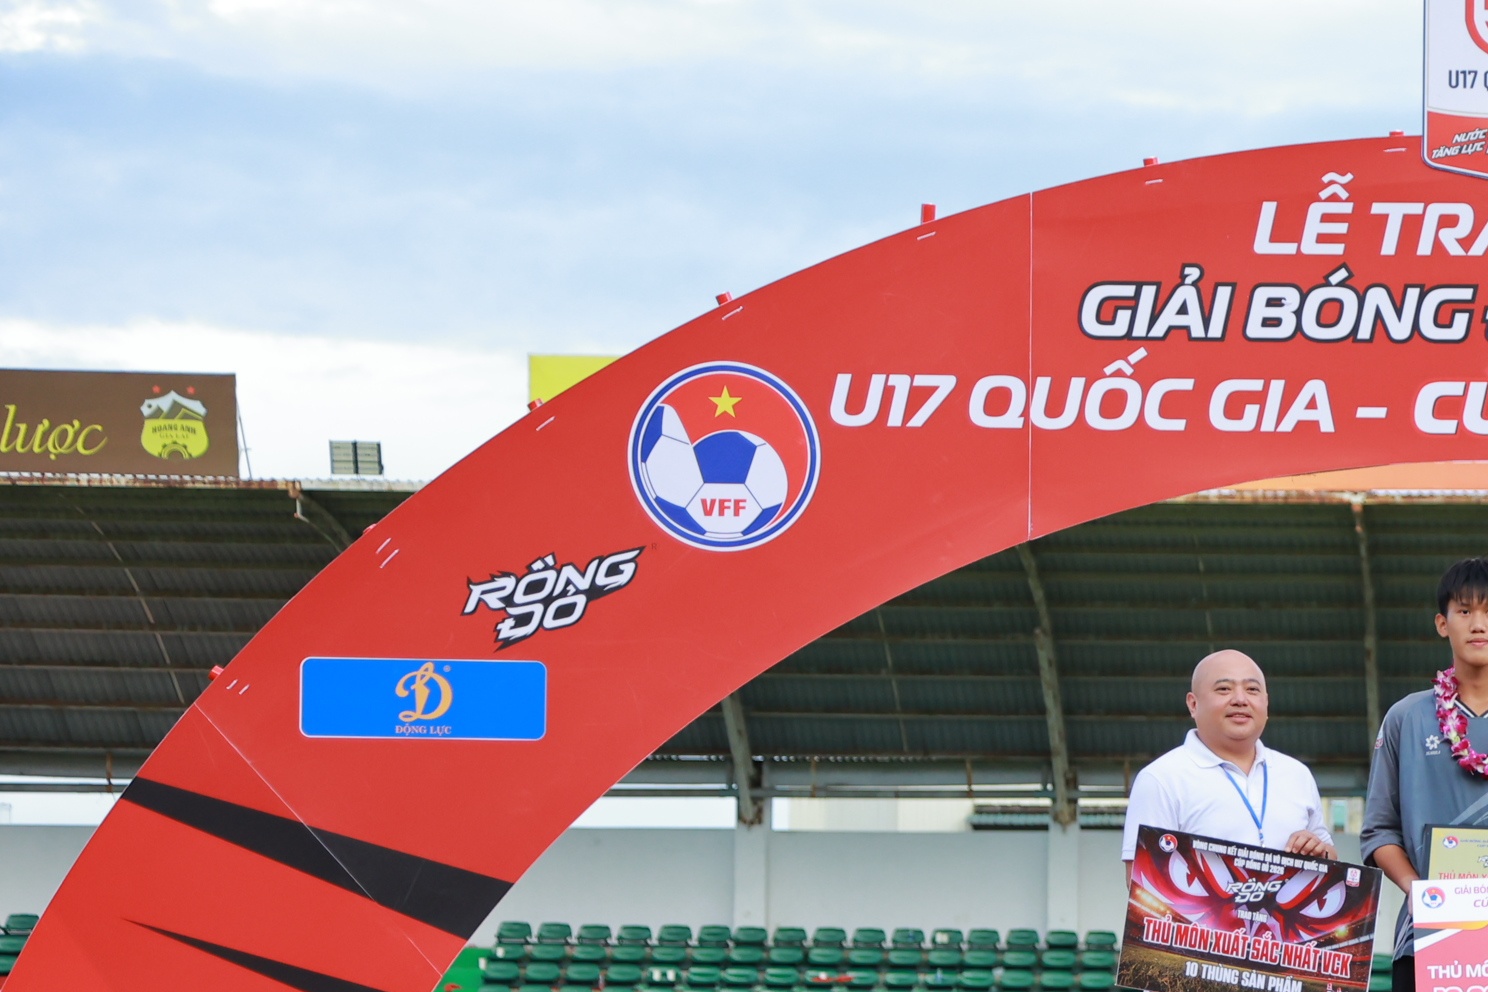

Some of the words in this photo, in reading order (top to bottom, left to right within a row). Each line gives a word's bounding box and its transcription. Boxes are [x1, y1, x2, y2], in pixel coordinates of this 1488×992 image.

[1448, 69, 1478, 89] U17
[1431, 146, 1460, 159] TĂNG
[1461, 141, 1486, 156] LỰC
[1452, 128, 1488, 144] NƯỚC
[1252, 172, 1355, 257] LỄ
[1079, 264, 1230, 343] GIẢI
[1243, 264, 1477, 344] BÓNG
[829, 373, 957, 428] U17
[968, 346, 1195, 431] QUỐC
[1208, 378, 1336, 433] GIA
[0, 404, 108, 460] lược
[700, 498, 747, 517] VFF
[462, 549, 643, 616] RỒNG
[495, 584, 588, 642] ĐỎ
[395, 723, 427, 736] ĐỘNG
[429, 725, 452, 736] LỰC
[1454, 885, 1472, 895] GIẢI
[1143, 914, 1173, 946] THỦ
[1173, 920, 1210, 952] MÔN
[1211, 927, 1250, 959] XUẤT
[1249, 931, 1281, 965] SẮC
[1280, 941, 1323, 974] NHẤT
[1322, 952, 1352, 979] VCK
[1185, 961, 1197, 978] 10
[1200, 962, 1239, 985] THÙNG
[1241, 969, 1265, 990] SẢN
[1427, 960, 1462, 979] THỦ
